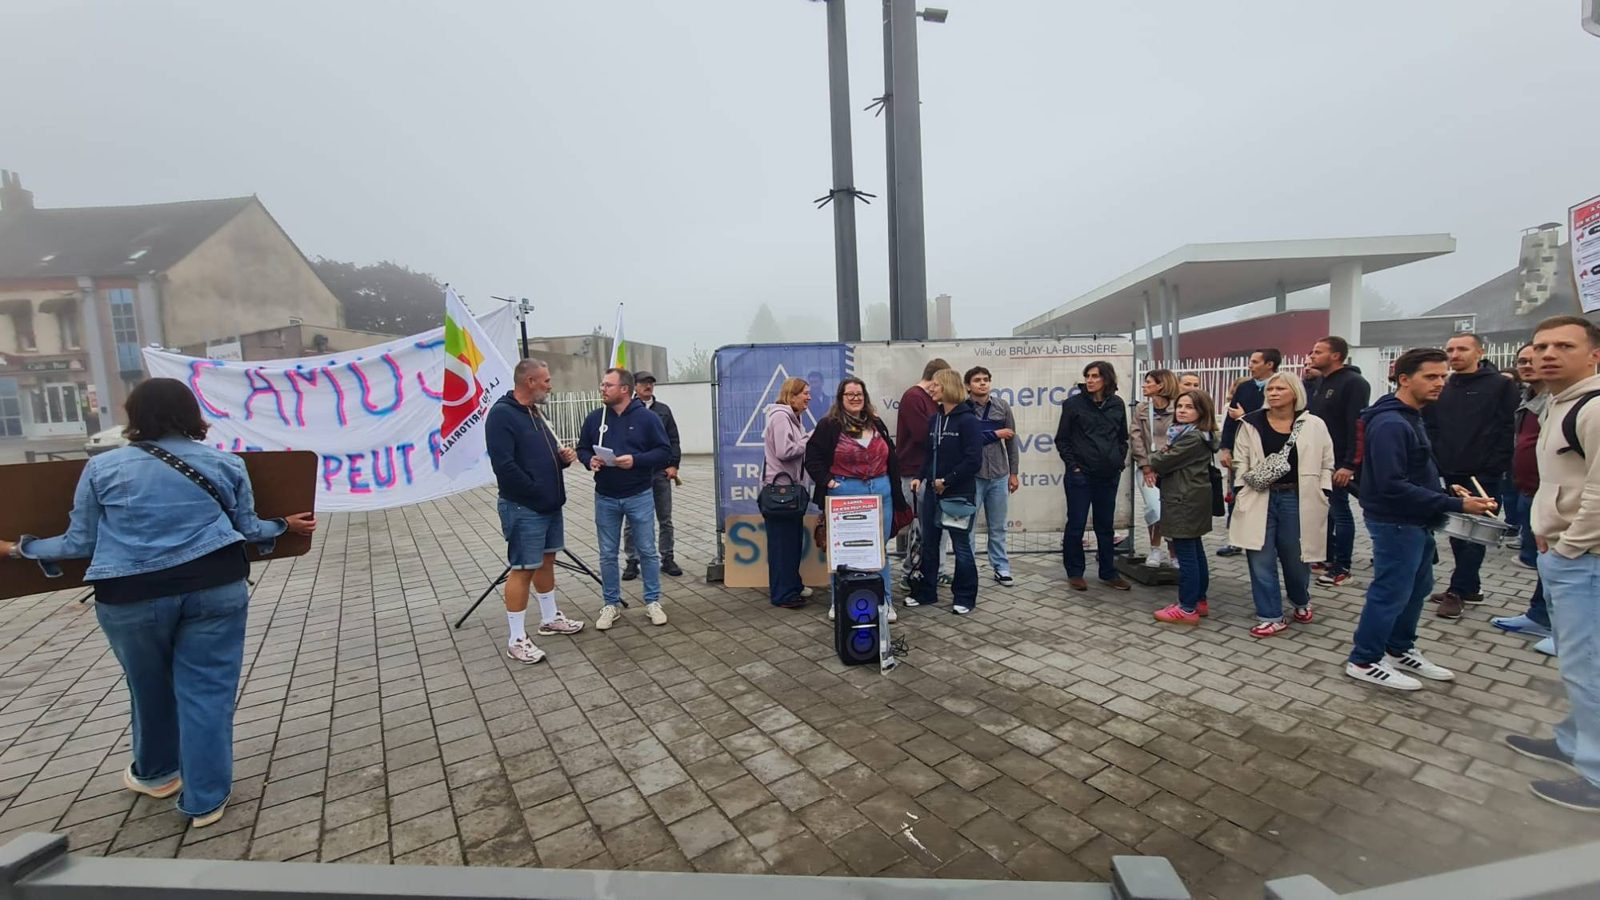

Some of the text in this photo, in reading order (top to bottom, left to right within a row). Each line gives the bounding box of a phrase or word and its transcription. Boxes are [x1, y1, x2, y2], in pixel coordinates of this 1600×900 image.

[975, 347, 992, 357] Ville
[995, 346, 1007, 356] de
[883, 398, 901, 410] Vo
[322, 442, 415, 494] PEUT
[1021, 471, 1062, 487] trav
